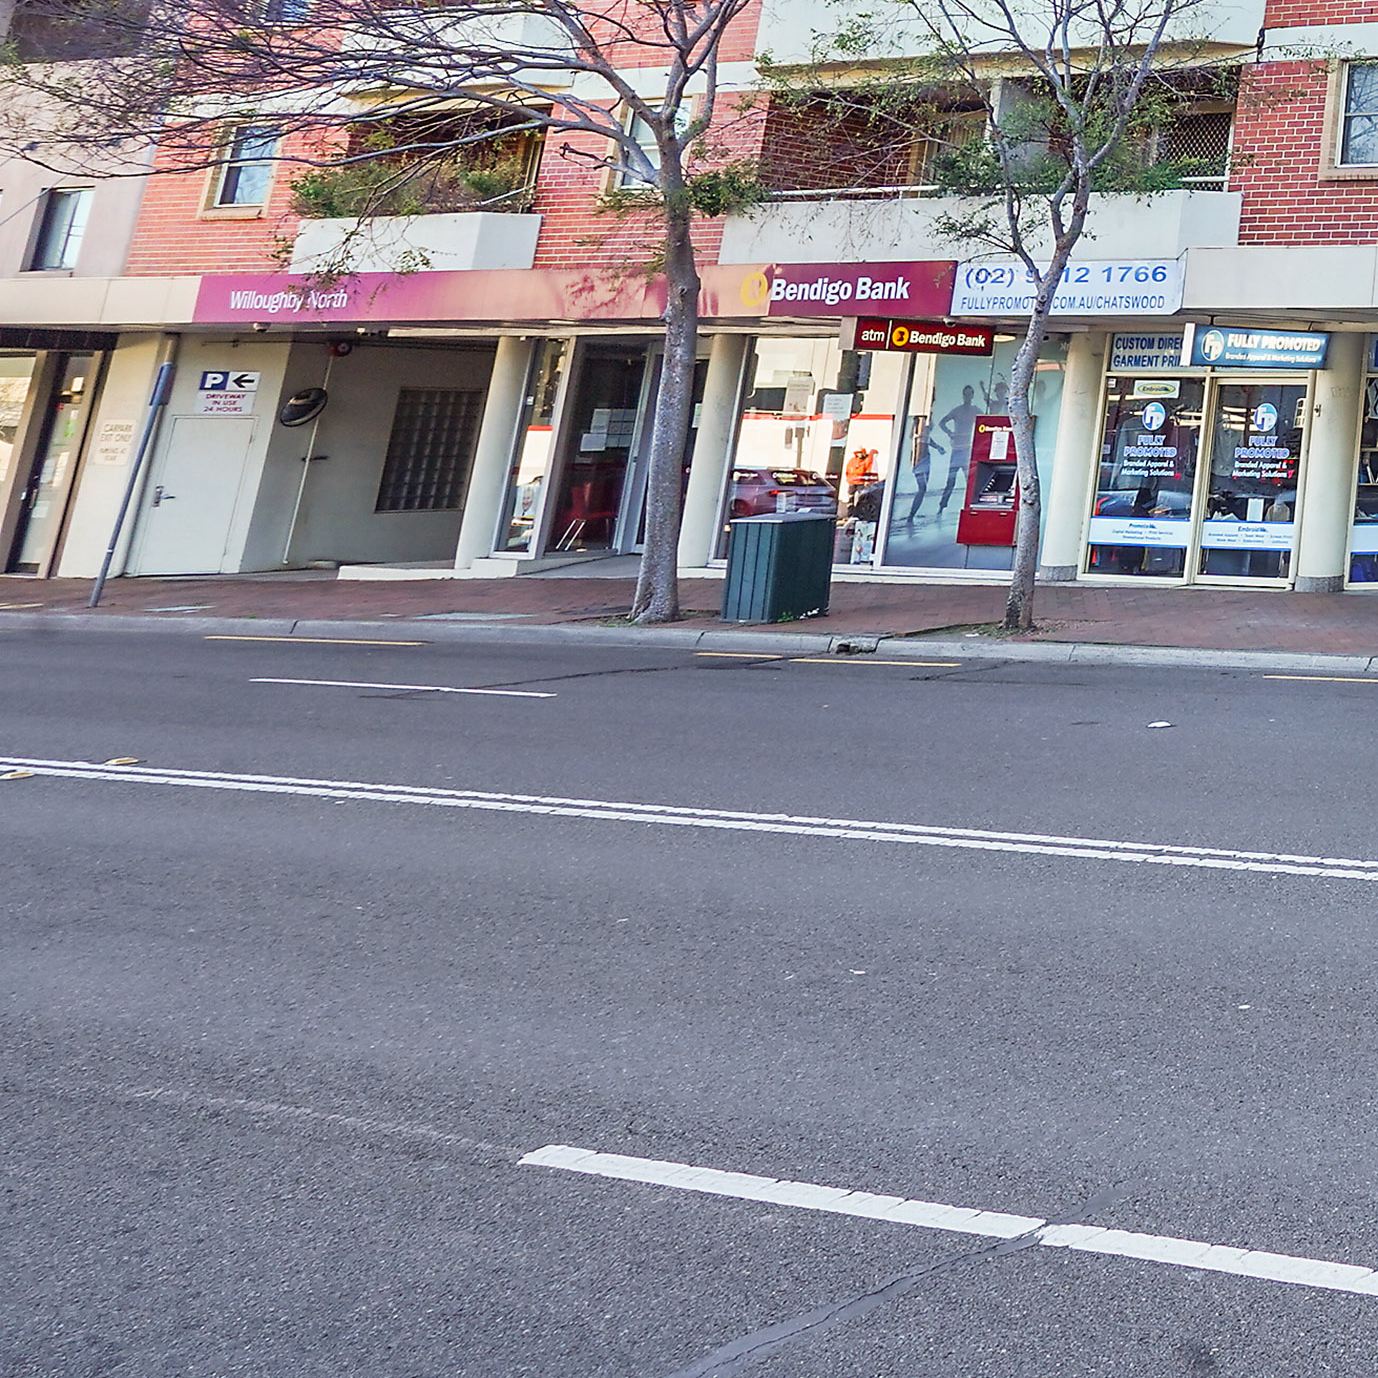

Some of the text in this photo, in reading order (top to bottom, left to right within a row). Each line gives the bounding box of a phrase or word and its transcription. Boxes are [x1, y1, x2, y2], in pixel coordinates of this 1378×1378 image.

[965, 265, 1168, 288] (02) 912 1766
[770, 277, 910, 305] Bendigo Bank
[229, 290, 302, 313] Willoughby
[961, 296, 1165, 310] FULLYPROMOTCOM.AU/CHATSWOOD
[861, 329, 986, 347] atm Bendigo Bank
[1115, 338, 1155, 350] CUSTOM
[1227, 334, 1322, 352] FULLY PROMOTED
[1113, 355, 1159, 367] GARMENT
[203, 372, 223, 389] P
[1138, 435, 1166, 446] FULLY
[1249, 436, 1278, 447] FULLY
[1124, 447, 1177, 458] PROMOTED
[1235, 448, 1290, 459] PROMOTED
